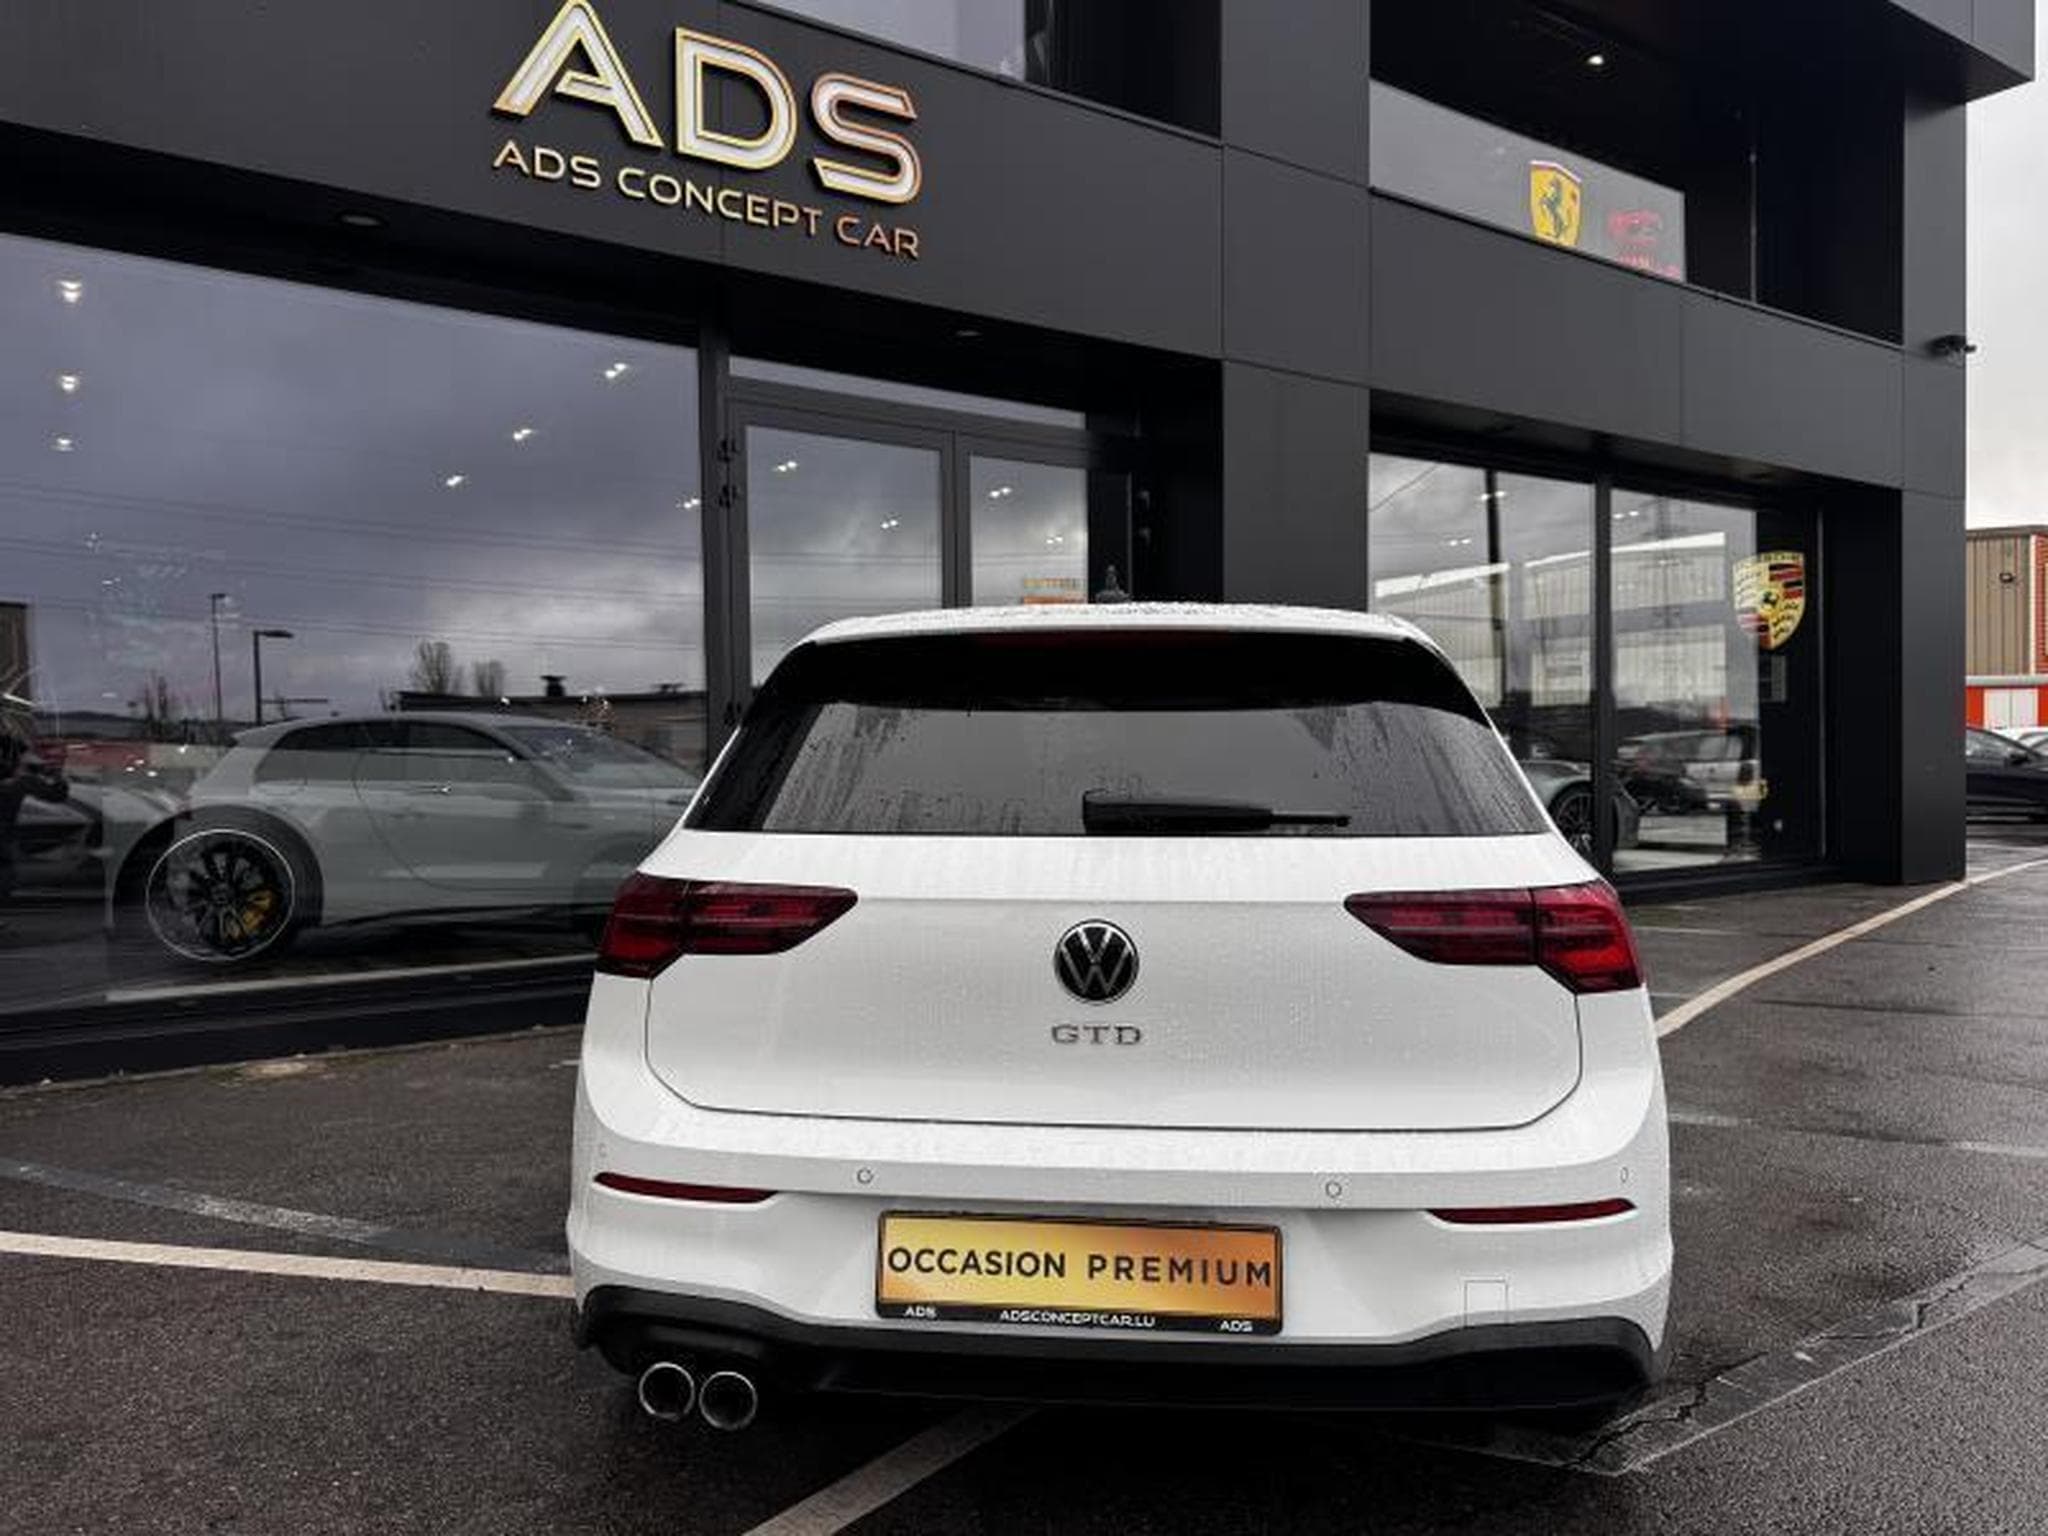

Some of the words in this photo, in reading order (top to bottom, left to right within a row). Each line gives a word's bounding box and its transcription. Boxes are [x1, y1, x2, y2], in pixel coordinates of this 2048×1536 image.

[492, 0, 922, 204] ADS
[494, 140, 602, 188] ADS
[616, 168, 822, 236] CONCEPT
[836, 214, 919, 259] CAR
[1051, 1024, 1141, 1045] GTD
[887, 1246, 1067, 1278] OCCASION
[1088, 1254, 1272, 1287] PREMIUM
[904, 1305, 938, 1319] ADS
[1219, 1319, 1254, 1333] ADS
